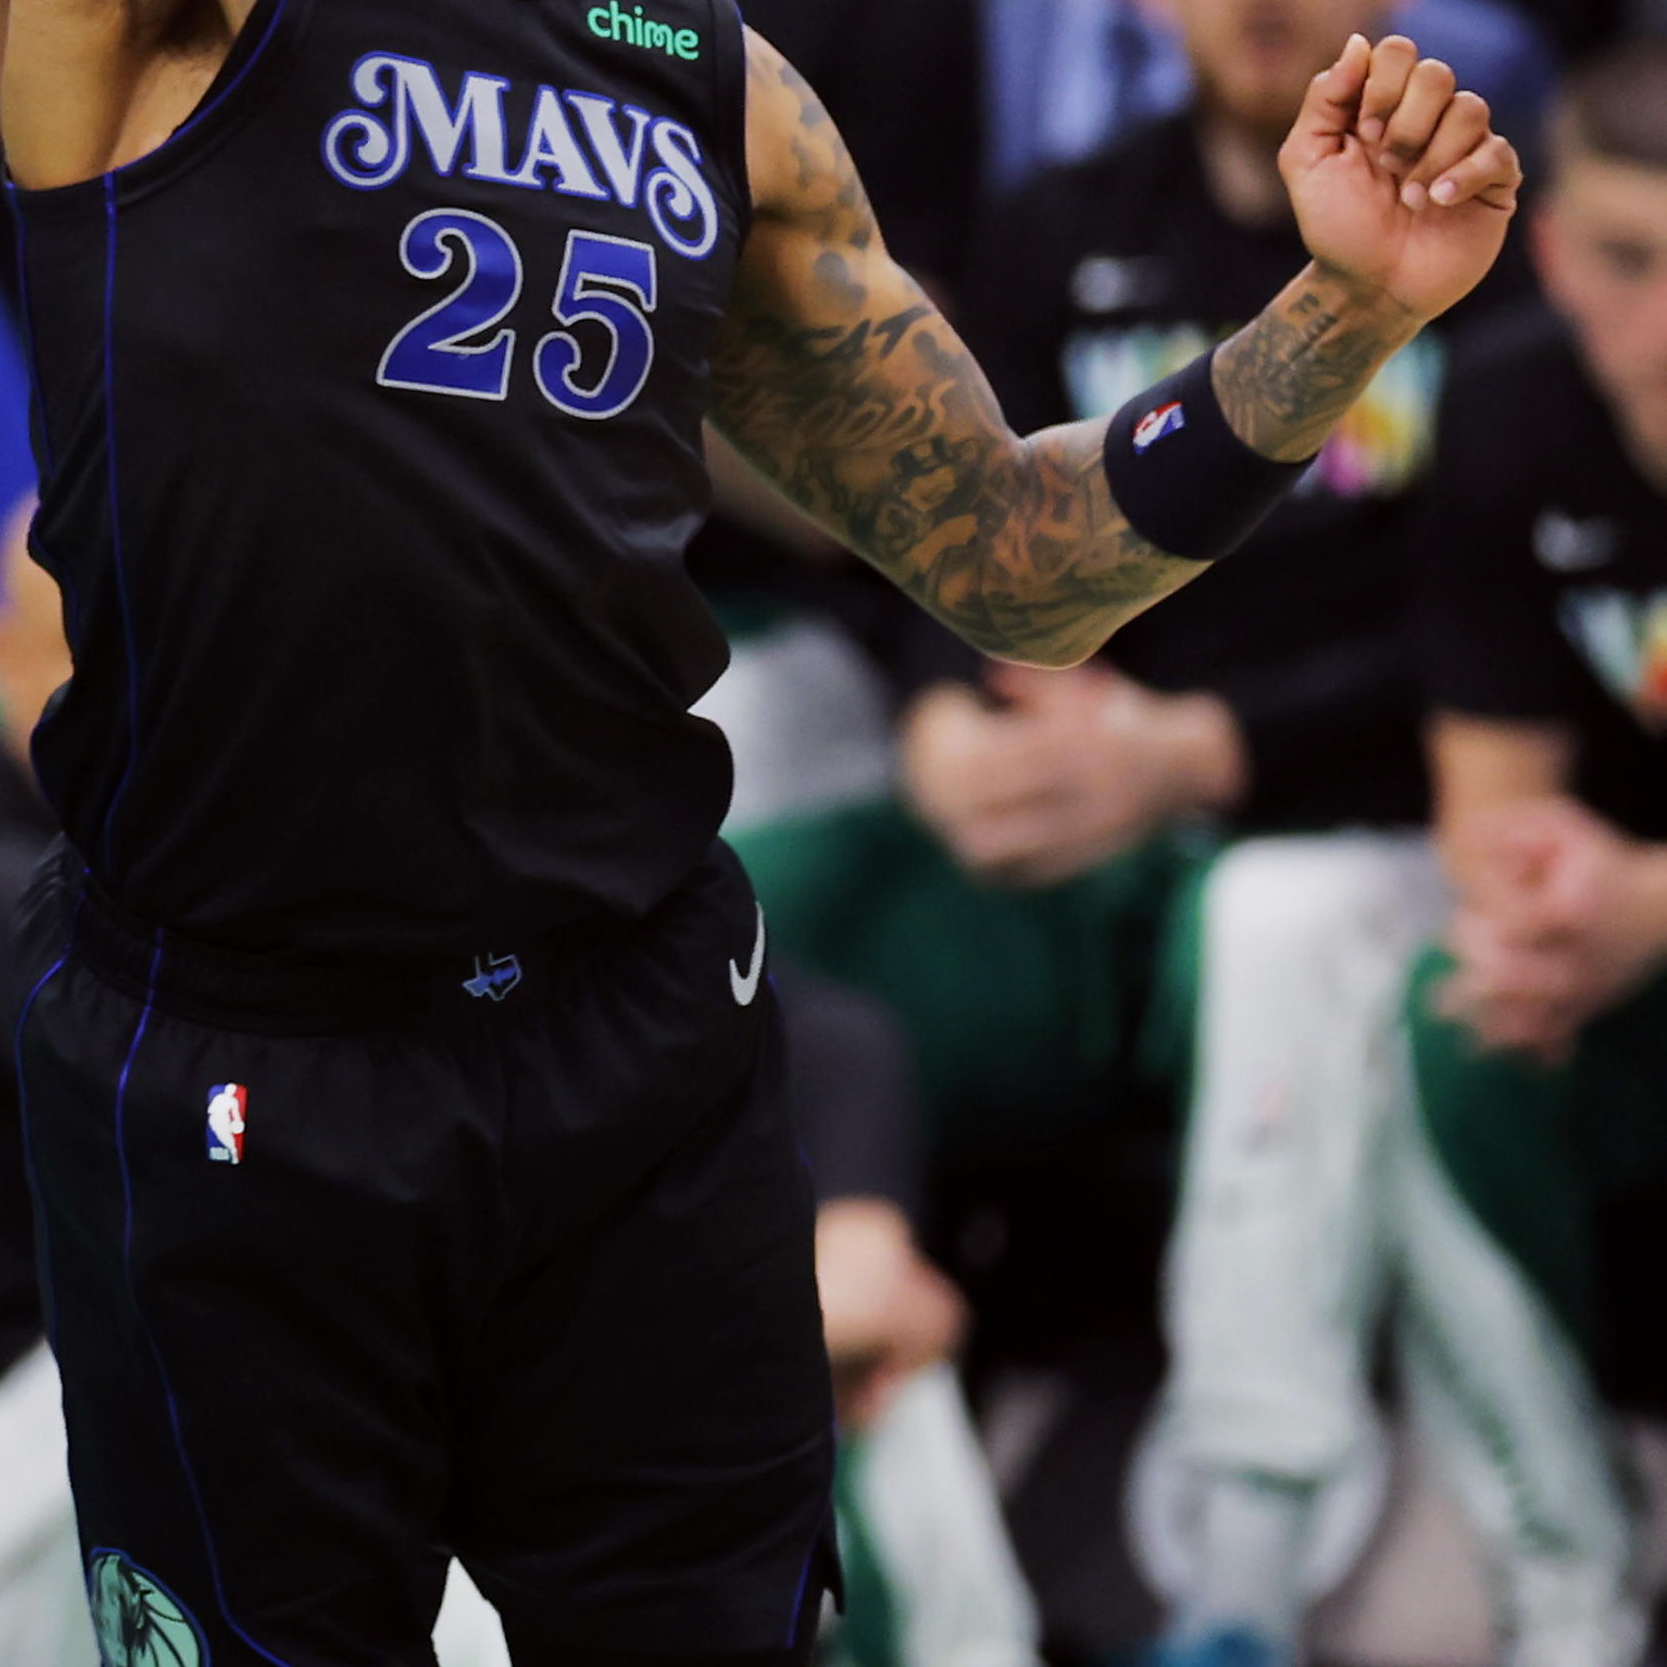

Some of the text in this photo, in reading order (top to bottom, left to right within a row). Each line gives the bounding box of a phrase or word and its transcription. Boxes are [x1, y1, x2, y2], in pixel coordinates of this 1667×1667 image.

[586, 0, 699, 61] chime
[320, 49, 719, 261] MAVS
[376, 207, 658, 420] 25
